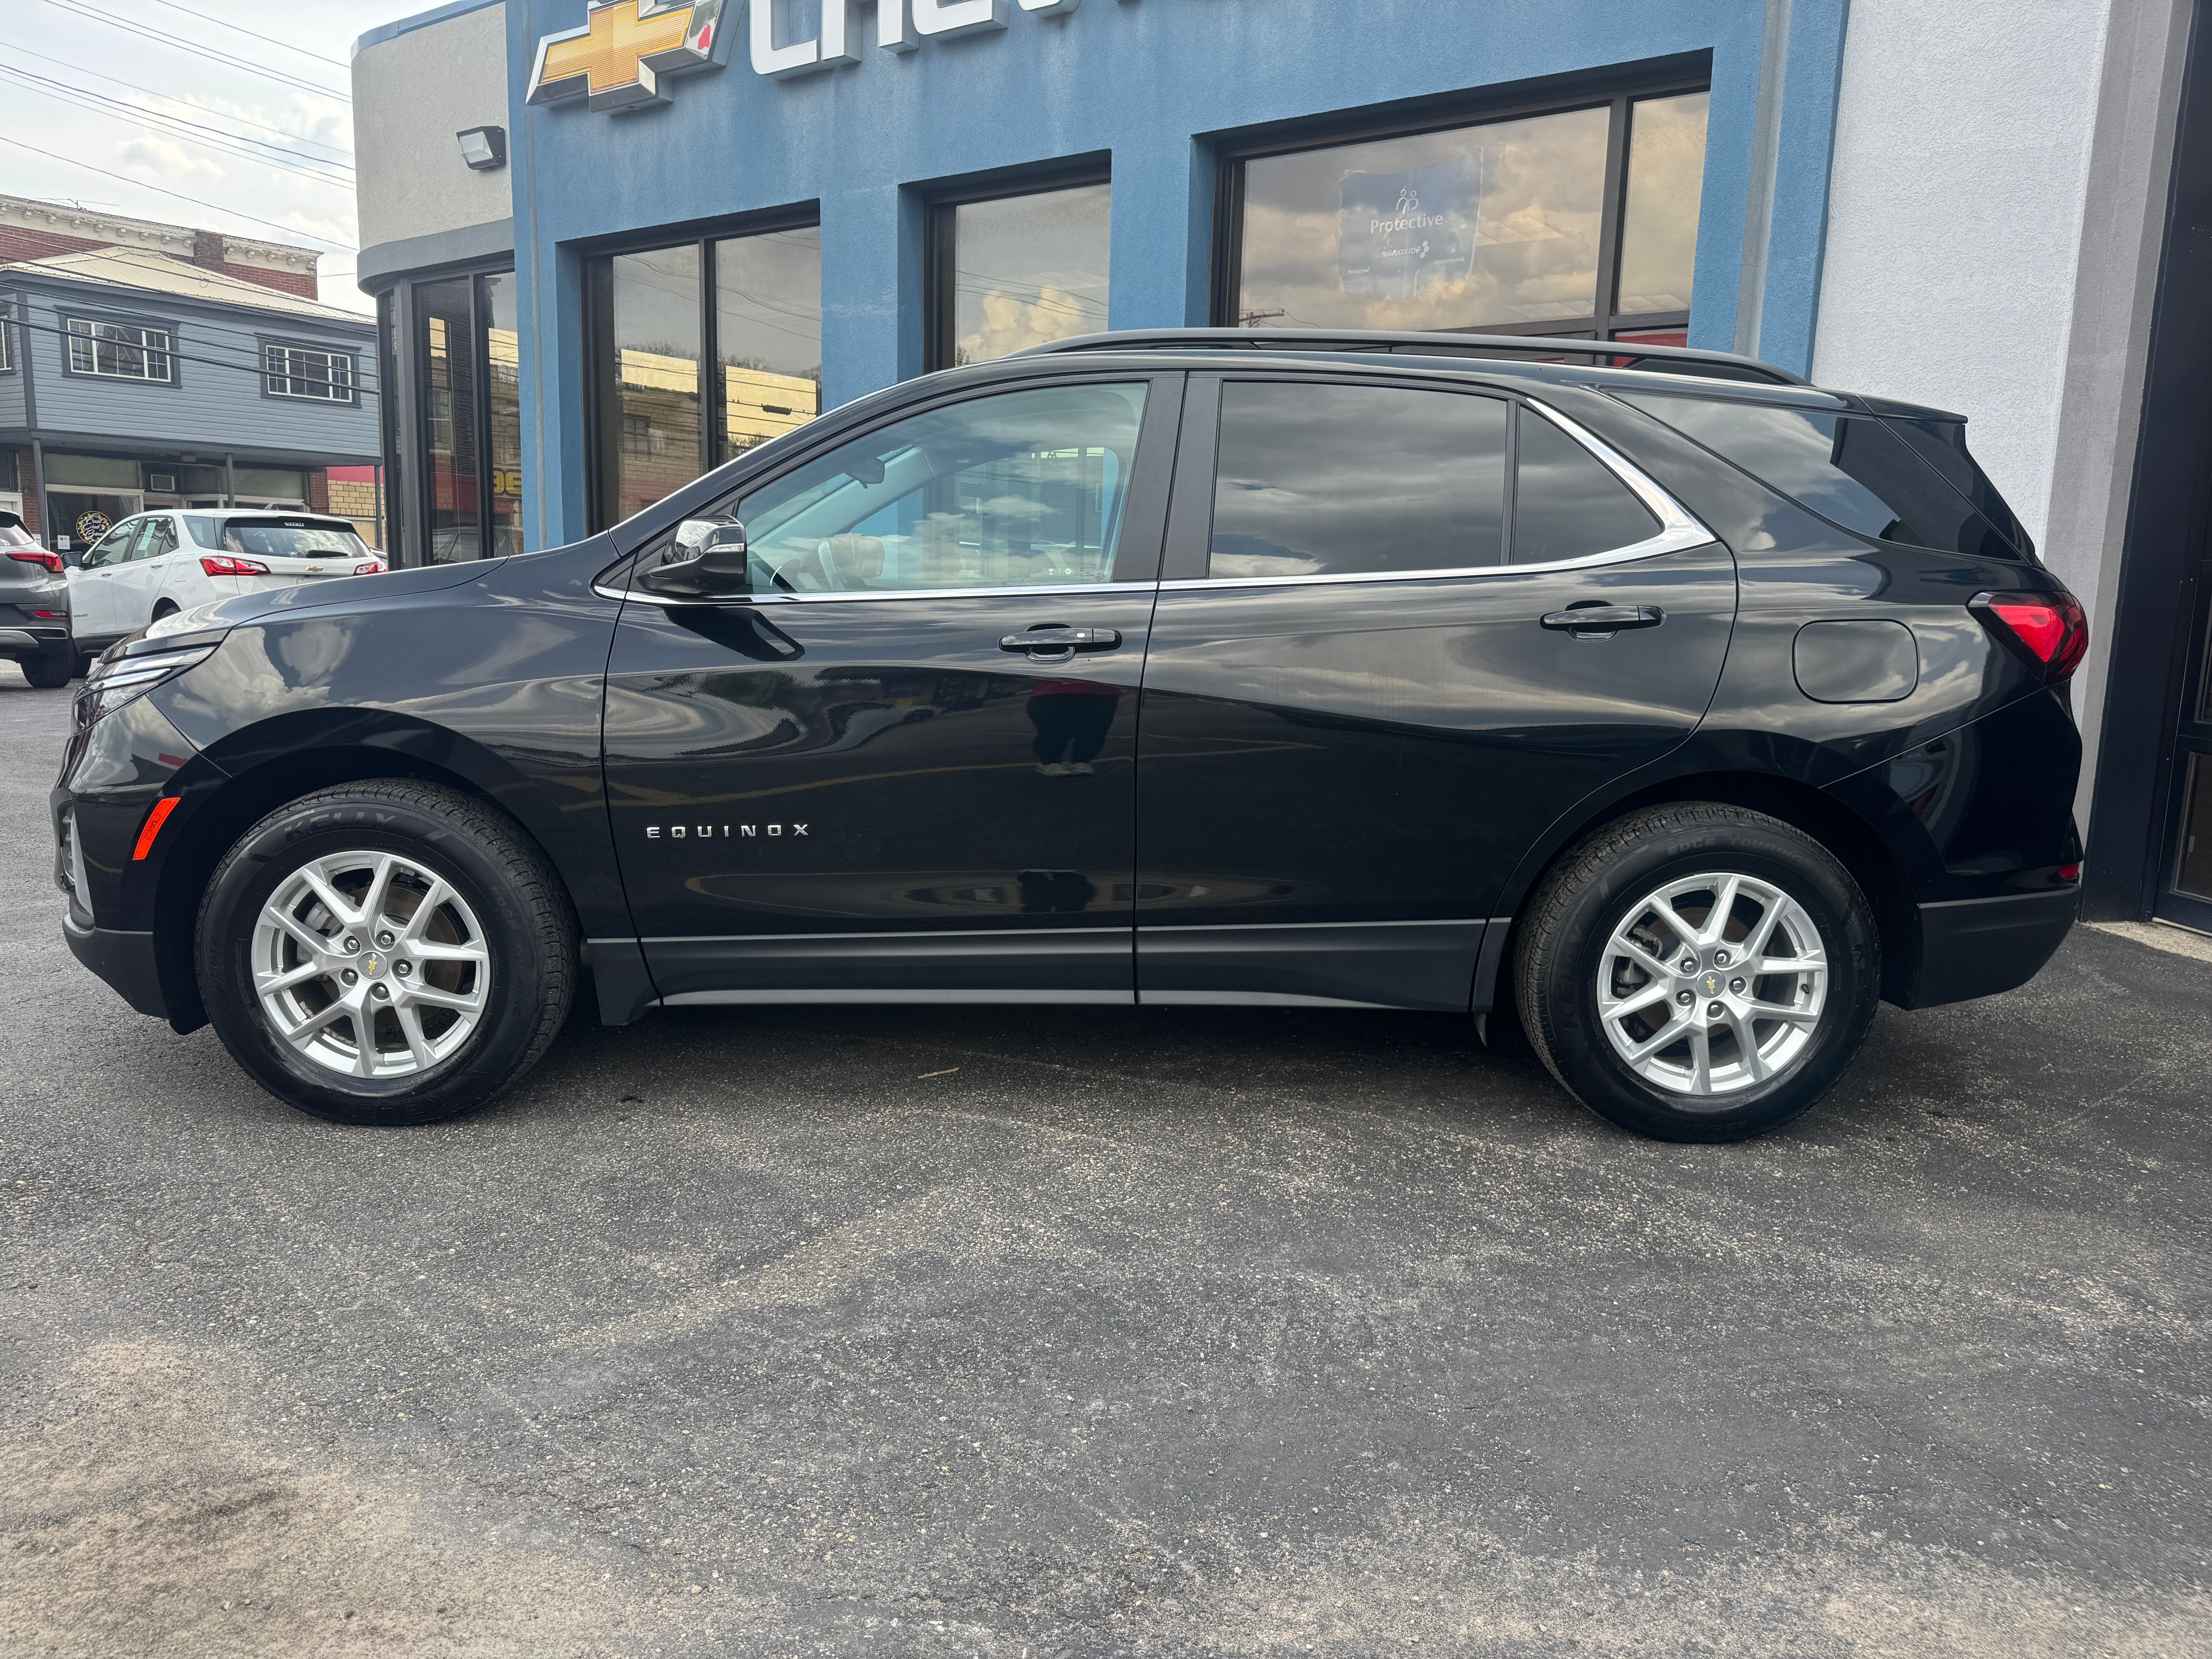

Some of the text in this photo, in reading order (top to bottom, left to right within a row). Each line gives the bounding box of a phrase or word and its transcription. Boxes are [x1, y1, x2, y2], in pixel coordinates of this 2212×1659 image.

[1370, 213, 1443, 234] Protective
[1381, 247, 1421, 258] NANOXIDE
[1434, 256, 1465, 265] Unprotected
[1348, 267, 1370, 275] Protected
[284, 811, 397, 842] KELLY
[646, 824, 809, 839] EQUINOX
